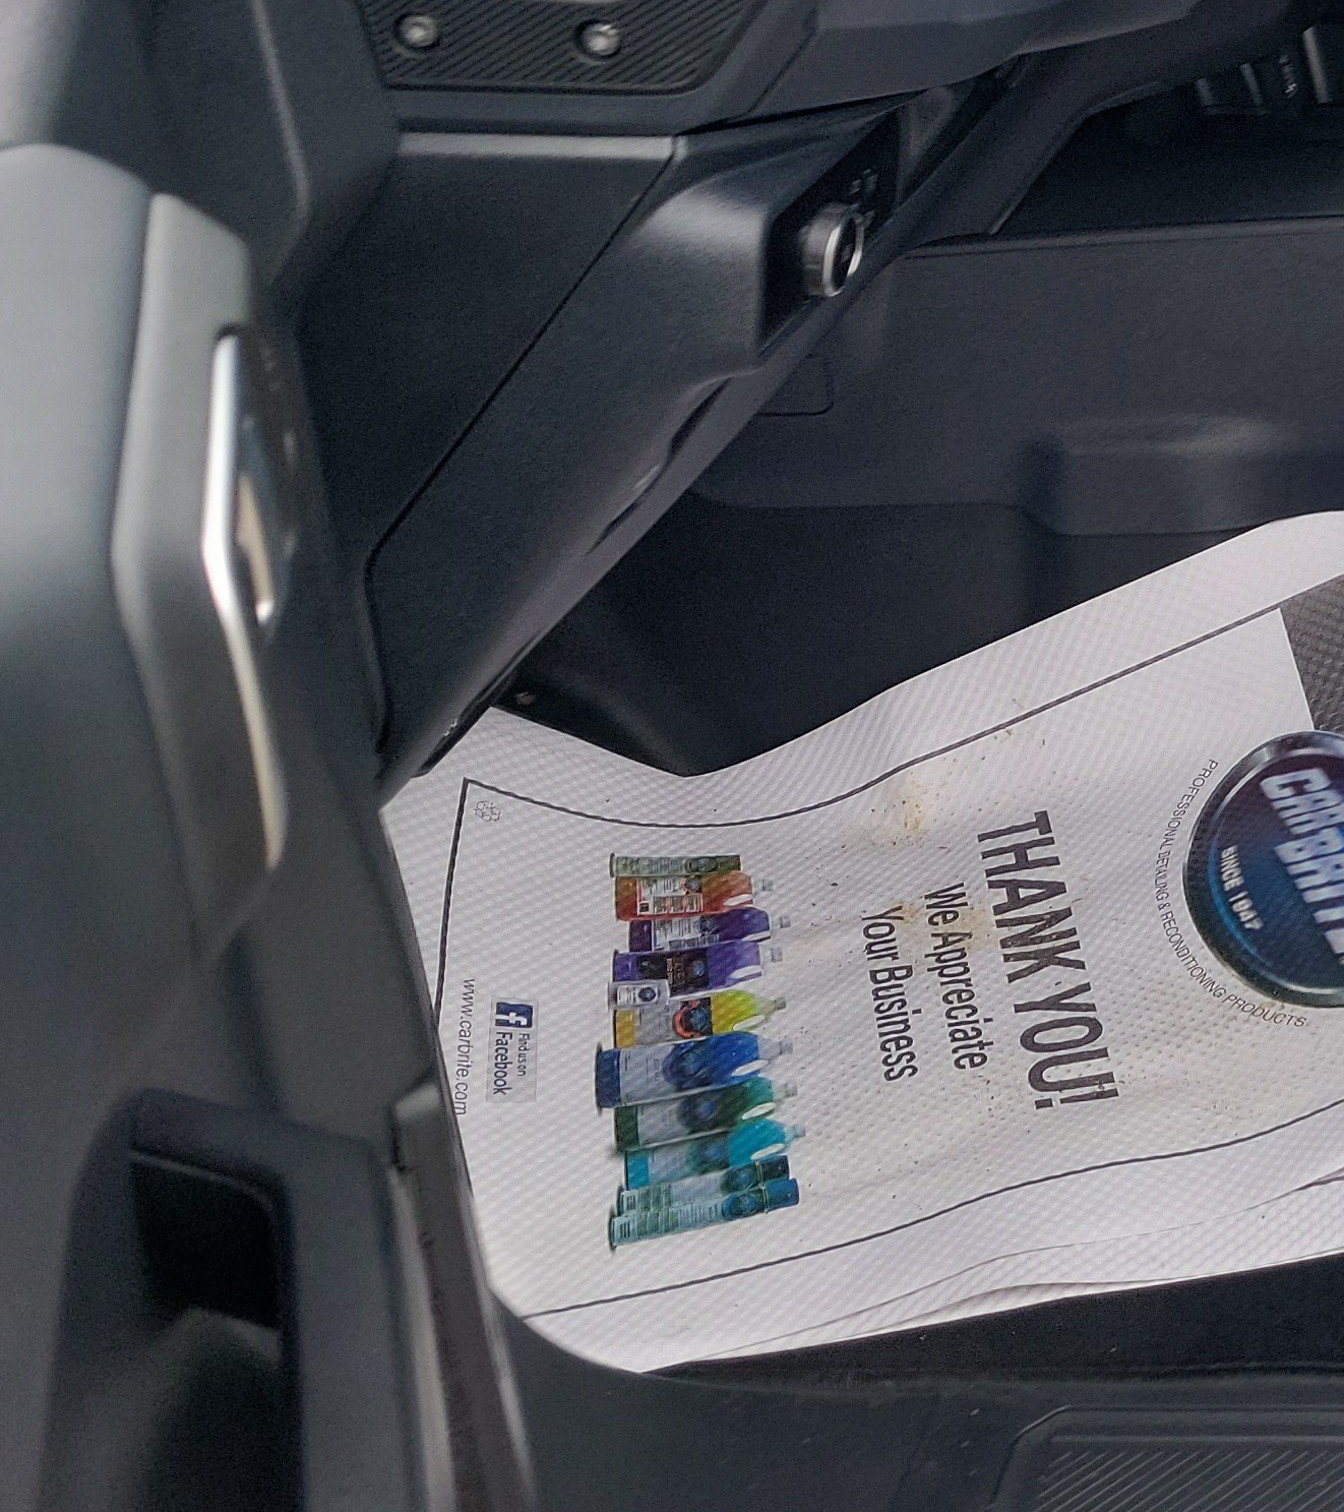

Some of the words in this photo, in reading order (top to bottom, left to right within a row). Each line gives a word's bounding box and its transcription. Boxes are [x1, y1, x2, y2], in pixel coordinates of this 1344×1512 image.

[1155, 757, 1219, 850] PROFESSIONAL
[976, 810, 1086, 985] THANK
[1155, 852, 1173, 901] DETAILING
[1217, 845, 1242, 891] SINCE
[859, 905, 909, 965] Your
[922, 882, 969, 928] We
[1227, 891, 1260, 932] 1947
[1157, 909, 1227, 1000] RECONDITIONING
[867, 963, 926, 1083] Business
[923, 926, 998, 1071] Appreciate
[1220, 994, 1306, 1029] PRODUCTS
[453, 978, 476, 1115] www.carbrite.com
[492, 1030, 512, 1095] Facebook
[516, 1032, 530, 1052] Find
[516, 1052, 528, 1064] us
[516, 1064, 527, 1076] on
[1011, 982, 1118, 1111] YOU!
